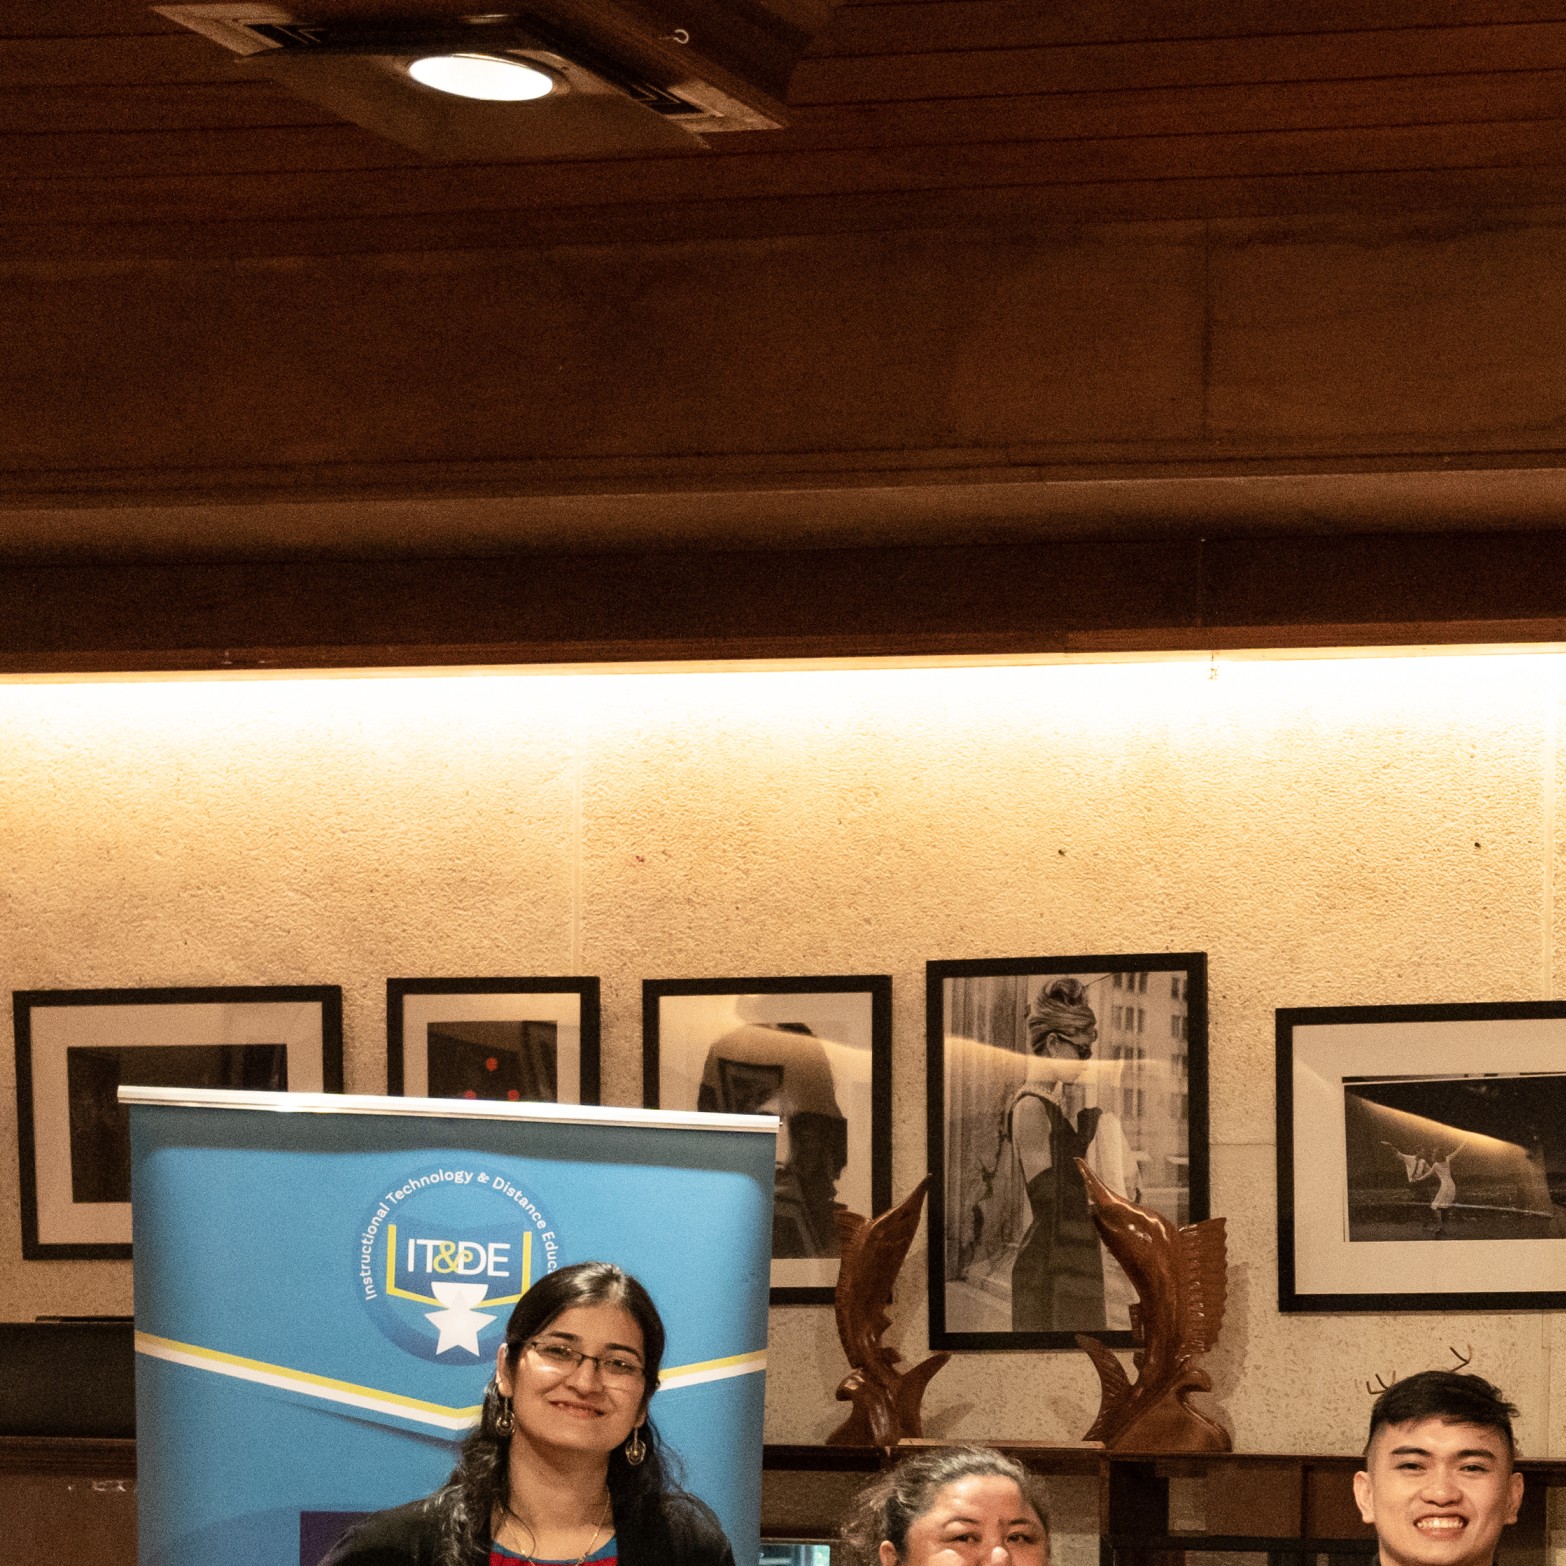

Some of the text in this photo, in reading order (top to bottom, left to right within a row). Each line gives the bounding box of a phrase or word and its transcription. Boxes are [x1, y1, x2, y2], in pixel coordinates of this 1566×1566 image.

[359, 1202, 390, 1301] Instructional
[385, 1169, 474, 1205] Technology
[477, 1171, 490, 1184] &
[491, 1176, 547, 1230] Distance
[407, 1238, 511, 1278] IT&DE
